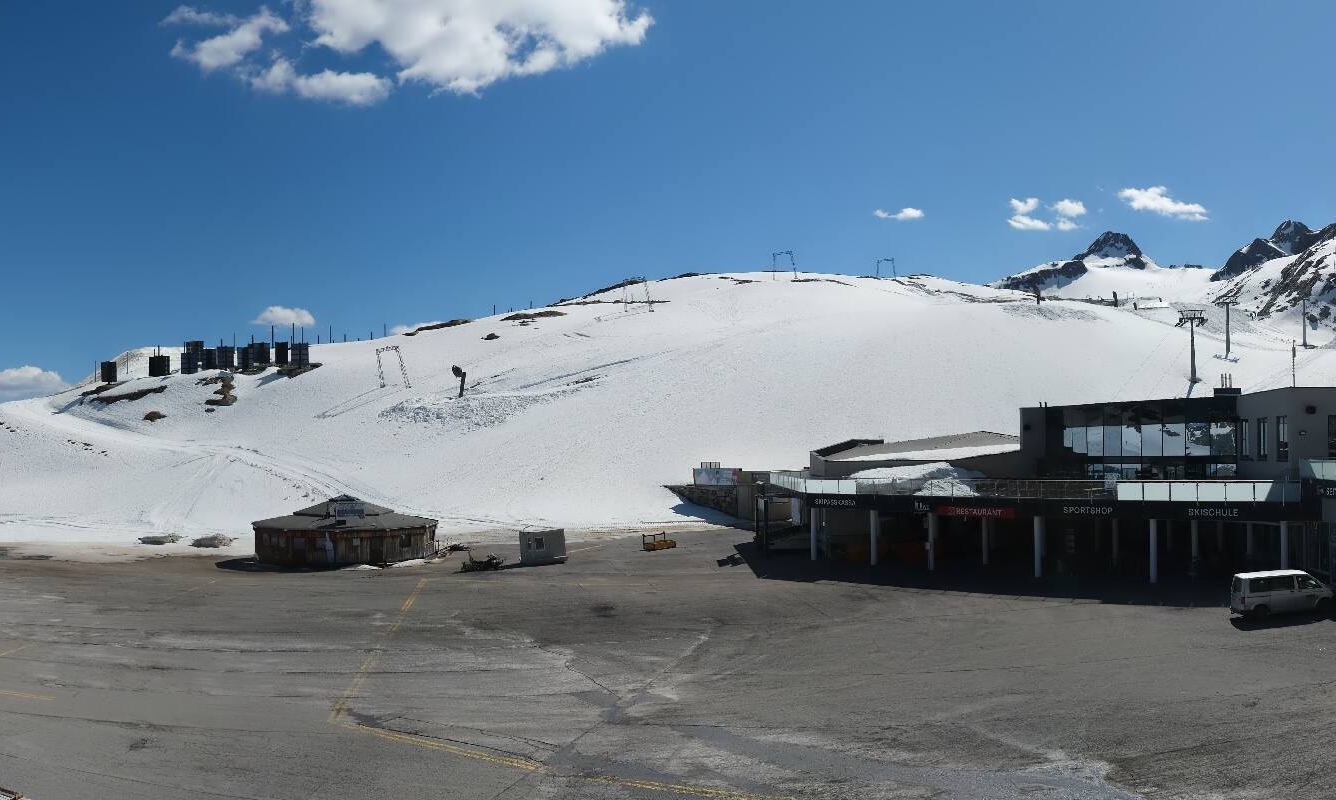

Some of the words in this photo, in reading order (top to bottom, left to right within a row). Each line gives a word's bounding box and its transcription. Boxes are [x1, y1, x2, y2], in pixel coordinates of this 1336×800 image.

[956, 507, 1003, 516] RESTAURANT
[1063, 506, 1113, 515] SPORTSHOP
[1188, 508, 1239, 517] SKISCHULE
